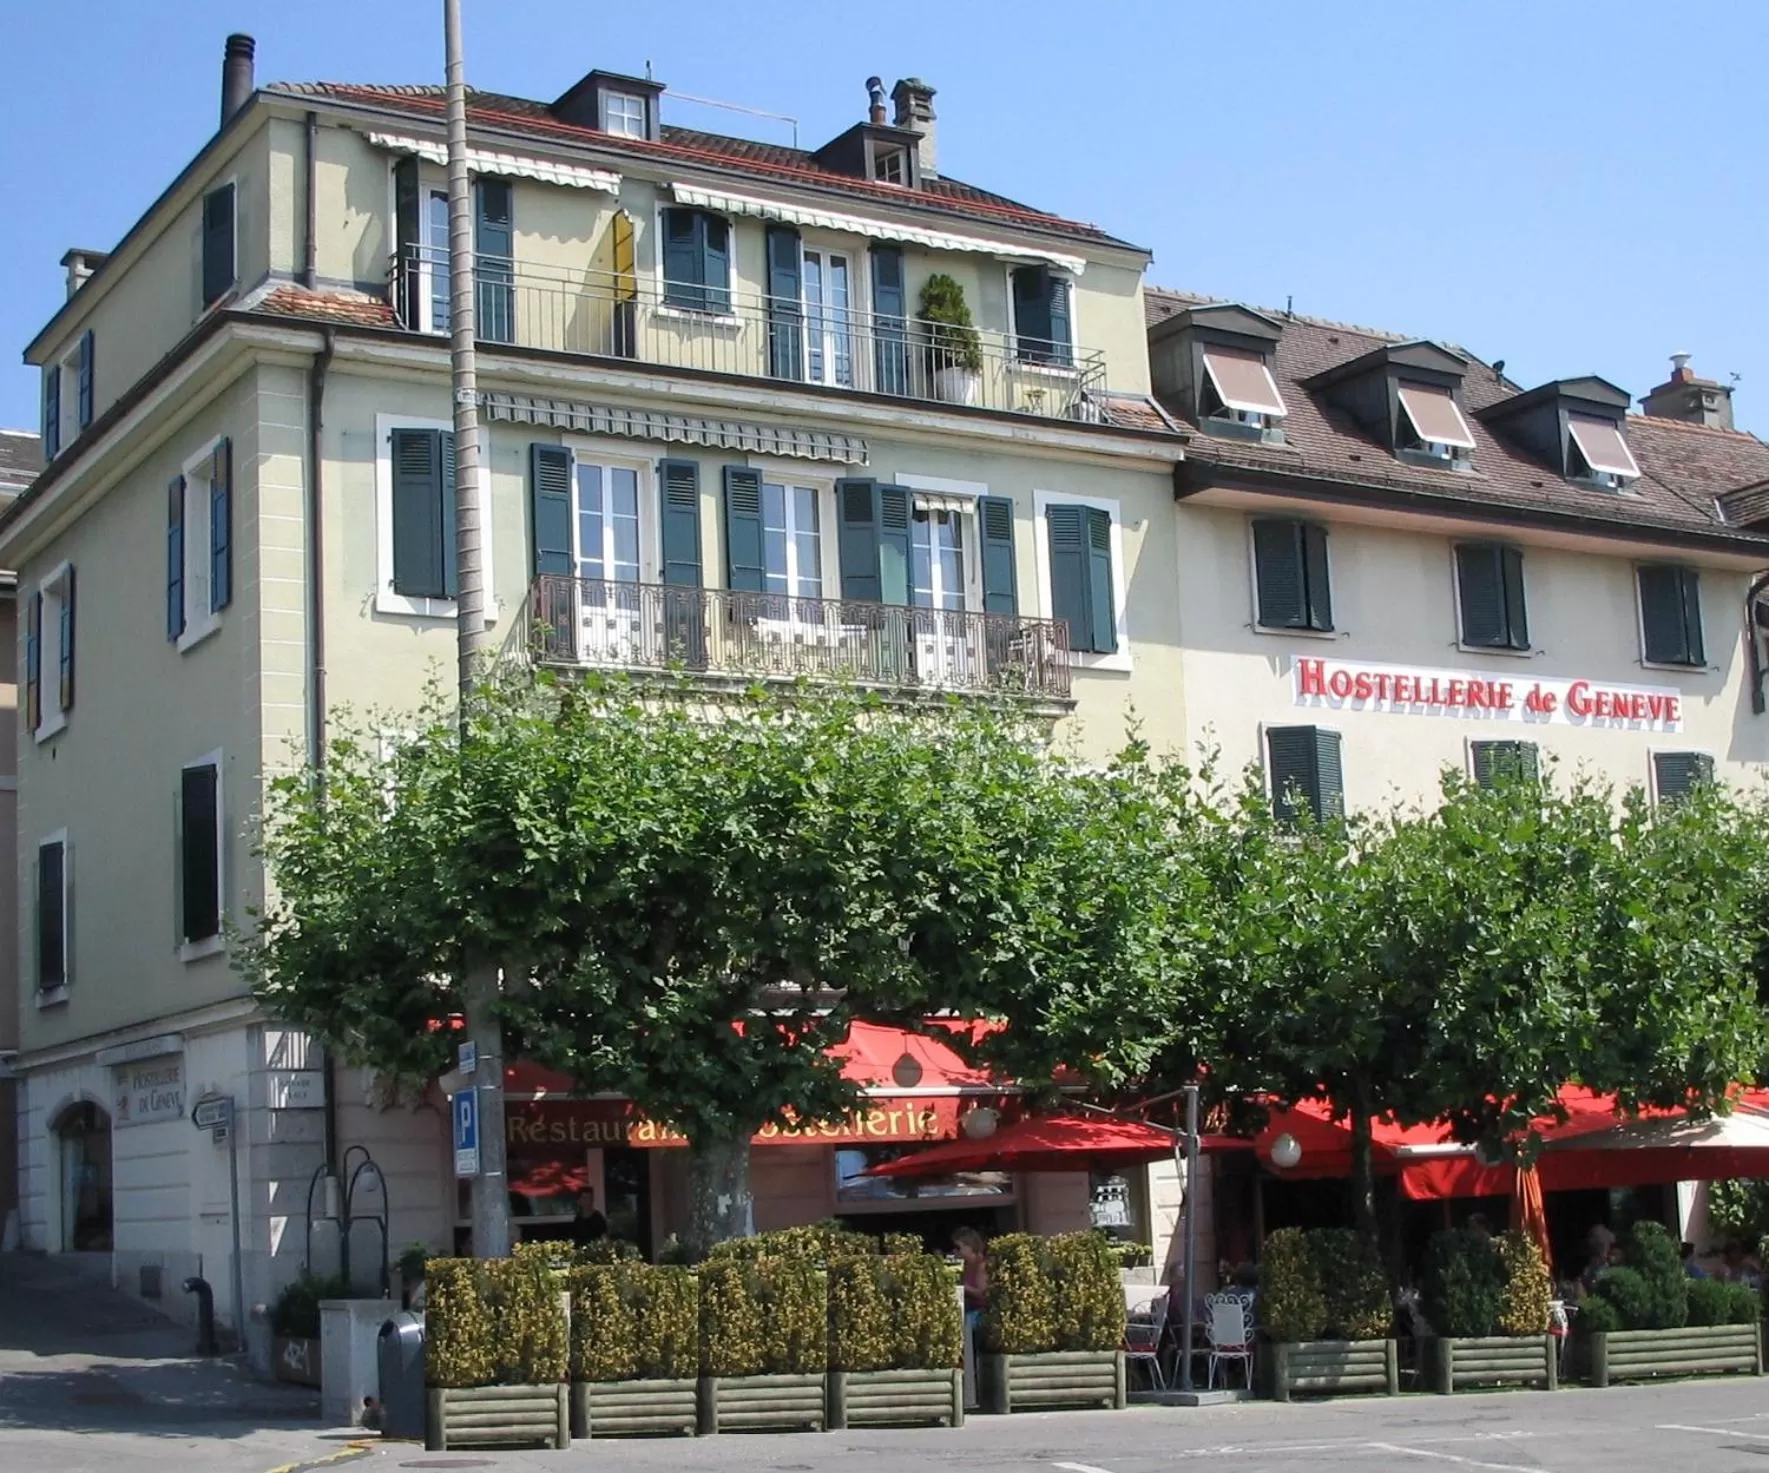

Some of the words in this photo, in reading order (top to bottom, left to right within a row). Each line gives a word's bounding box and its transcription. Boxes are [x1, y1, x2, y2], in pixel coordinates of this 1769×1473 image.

[1299, 658, 1515, 709] HOSTELLERIE
[1526, 682, 1557, 713] de
[1567, 680, 1682, 723] GENEVE
[508, 1116, 688, 1142] Restaura
